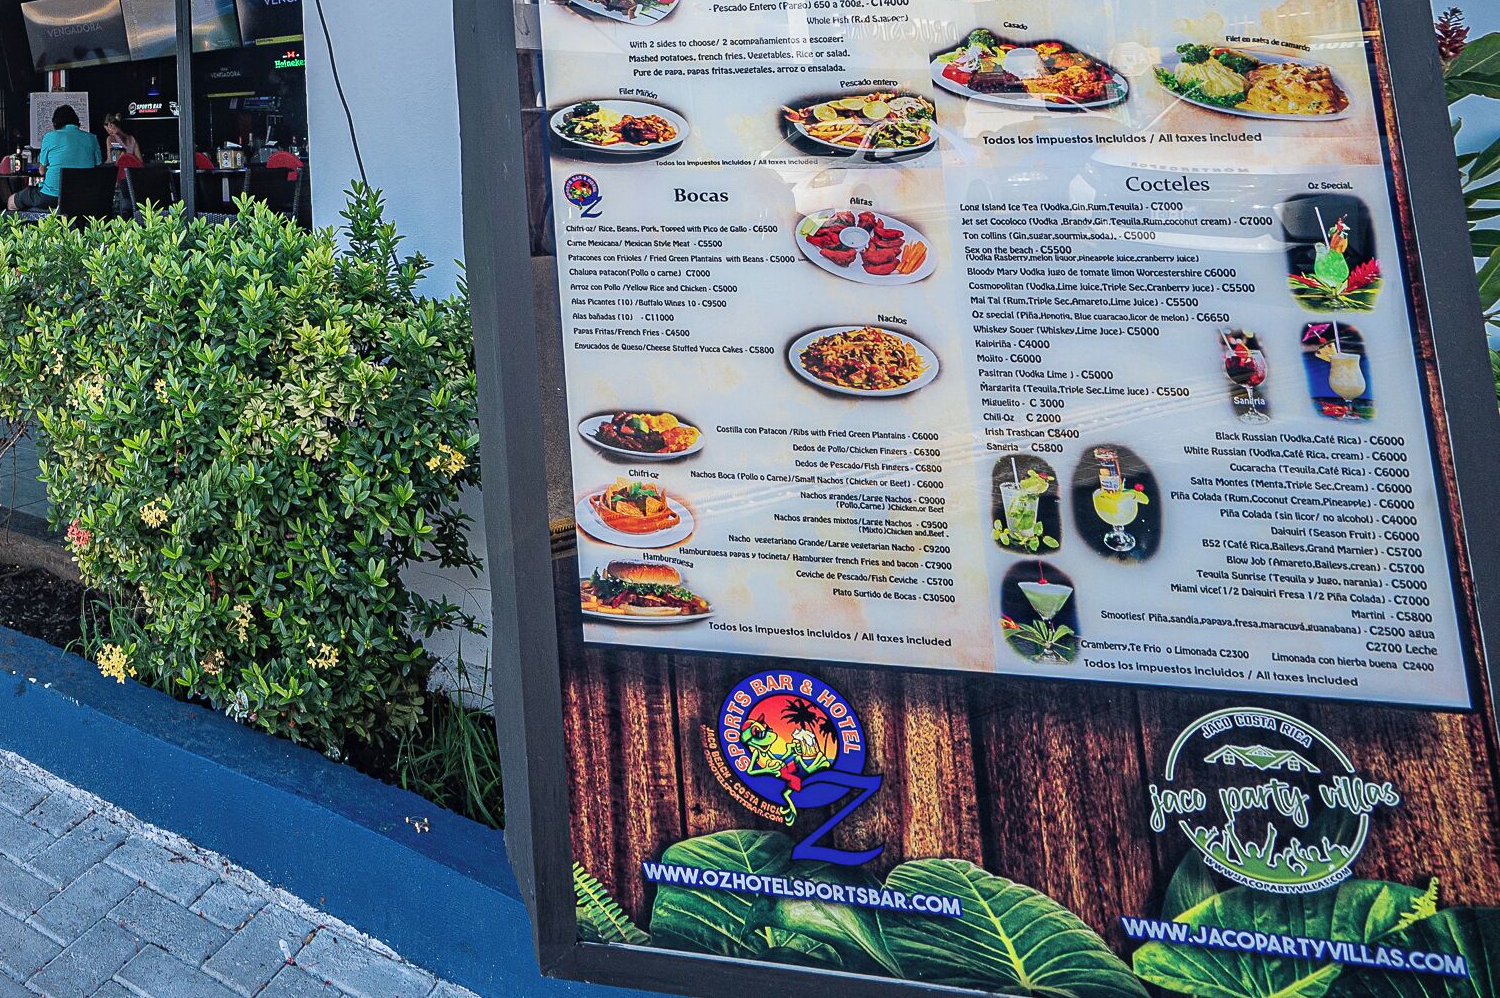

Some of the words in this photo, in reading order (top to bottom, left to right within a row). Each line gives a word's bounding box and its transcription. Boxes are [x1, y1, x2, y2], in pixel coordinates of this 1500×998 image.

[47, 24, 102, 38] VENGADORA
[1003, 21, 1028, 31] Casado
[274, 58, 306, 69] Heineke
[839, 78, 872, 88] Pescado
[872, 79, 898, 87] entero
[982, 135, 1016, 145] Todos
[1017, 135, 1034, 145] los
[1035, 135, 1094, 146] impuestos
[1095, 134, 1147, 144] incluidos
[1158, 133, 1173, 143] All
[1175, 133, 1208, 143] taxes
[1209, 132, 1262, 142] included
[1125, 175, 1210, 192] Cocteles
[1307, 182, 1320, 190] Oz
[673, 188, 729, 203] Bocas
[849, 197, 873, 207] Alitas
[877, 314, 908, 325] Nachos
[573, 327, 594, 335] Papas
[642, 328, 660, 337] Fries
[665, 328, 690, 337] C4500
[1018, 339, 1050, 349] C4000
[976, 354, 1004, 363] Mojito
[1009, 353, 1042, 364] C6000
[985, 427, 1005, 436] Irish
[1005, 428, 1045, 438] Trashcan
[1047, 428, 1080, 439] C8400
[986, 442, 1019, 452] Sangria
[1031, 442, 1064, 453] C5800
[1270, 526, 1307, 537] Daiquiri
[1383, 530, 1420, 542] C6000
[642, 552, 694, 569] Hamburguesa
[832, 588, 853, 597] Plato
[853, 589, 882, 599] Surtido
[882, 591, 893, 600] de
[893, 592, 917, 601] Bocas
[922, 593, 956, 603] C30500
[1351, 609, 1386, 620] Martini
[1396, 611, 1433, 623] C5800
[1365, 641, 1403, 654] C2700
[1405, 643, 1438, 656] Leche
[724, 690, 752, 772] SPORTS
[750, 674, 793, 696] BAR
[799, 679, 813, 696] &
[817, 689, 861, 754] HOTEL
[706, 727, 717, 749] JACO
[1203, 716, 1231, 739] JACO
[1234, 714, 1276, 730] COSTA
[1280, 721, 1313, 748] RICA
[711, 751, 731, 778] BEACH
[733, 782, 759, 805] COSTA
[1149, 784, 1206, 832] jaco
[1219, 778, 1310, 827] party
[1318, 775, 1399, 814] villas
[643, 862, 962, 916] WWW.OZHOTELSPORTSBAR.COM
[1122, 918, 1466, 976] WWW.JACOPARTYVILLAS.COM
